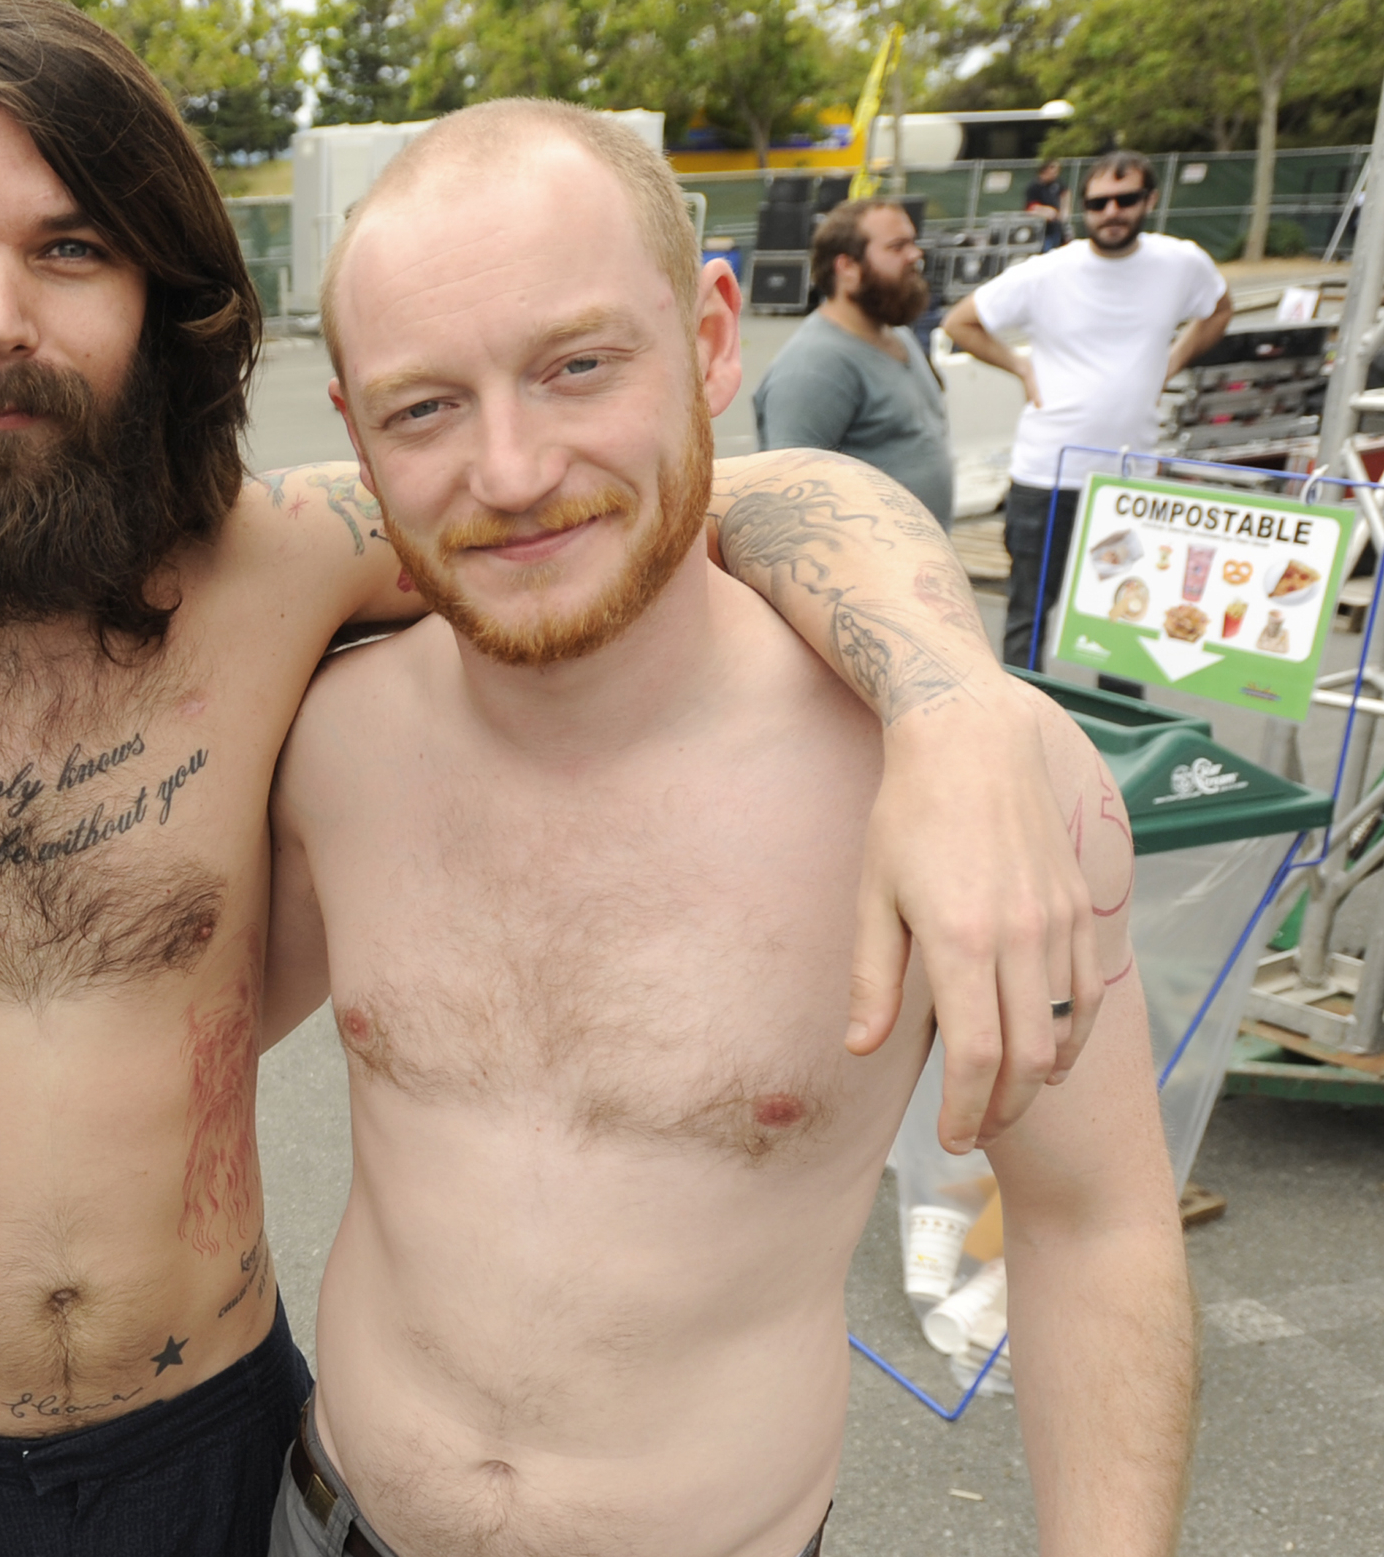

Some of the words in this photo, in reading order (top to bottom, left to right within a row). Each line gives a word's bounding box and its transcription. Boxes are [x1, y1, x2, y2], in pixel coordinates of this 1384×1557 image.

[1114, 493, 1313, 546] COMPOSTABLE
[56, 732, 146, 792] knows
[37, 786, 148, 863] without
[156, 748, 209, 826] you
